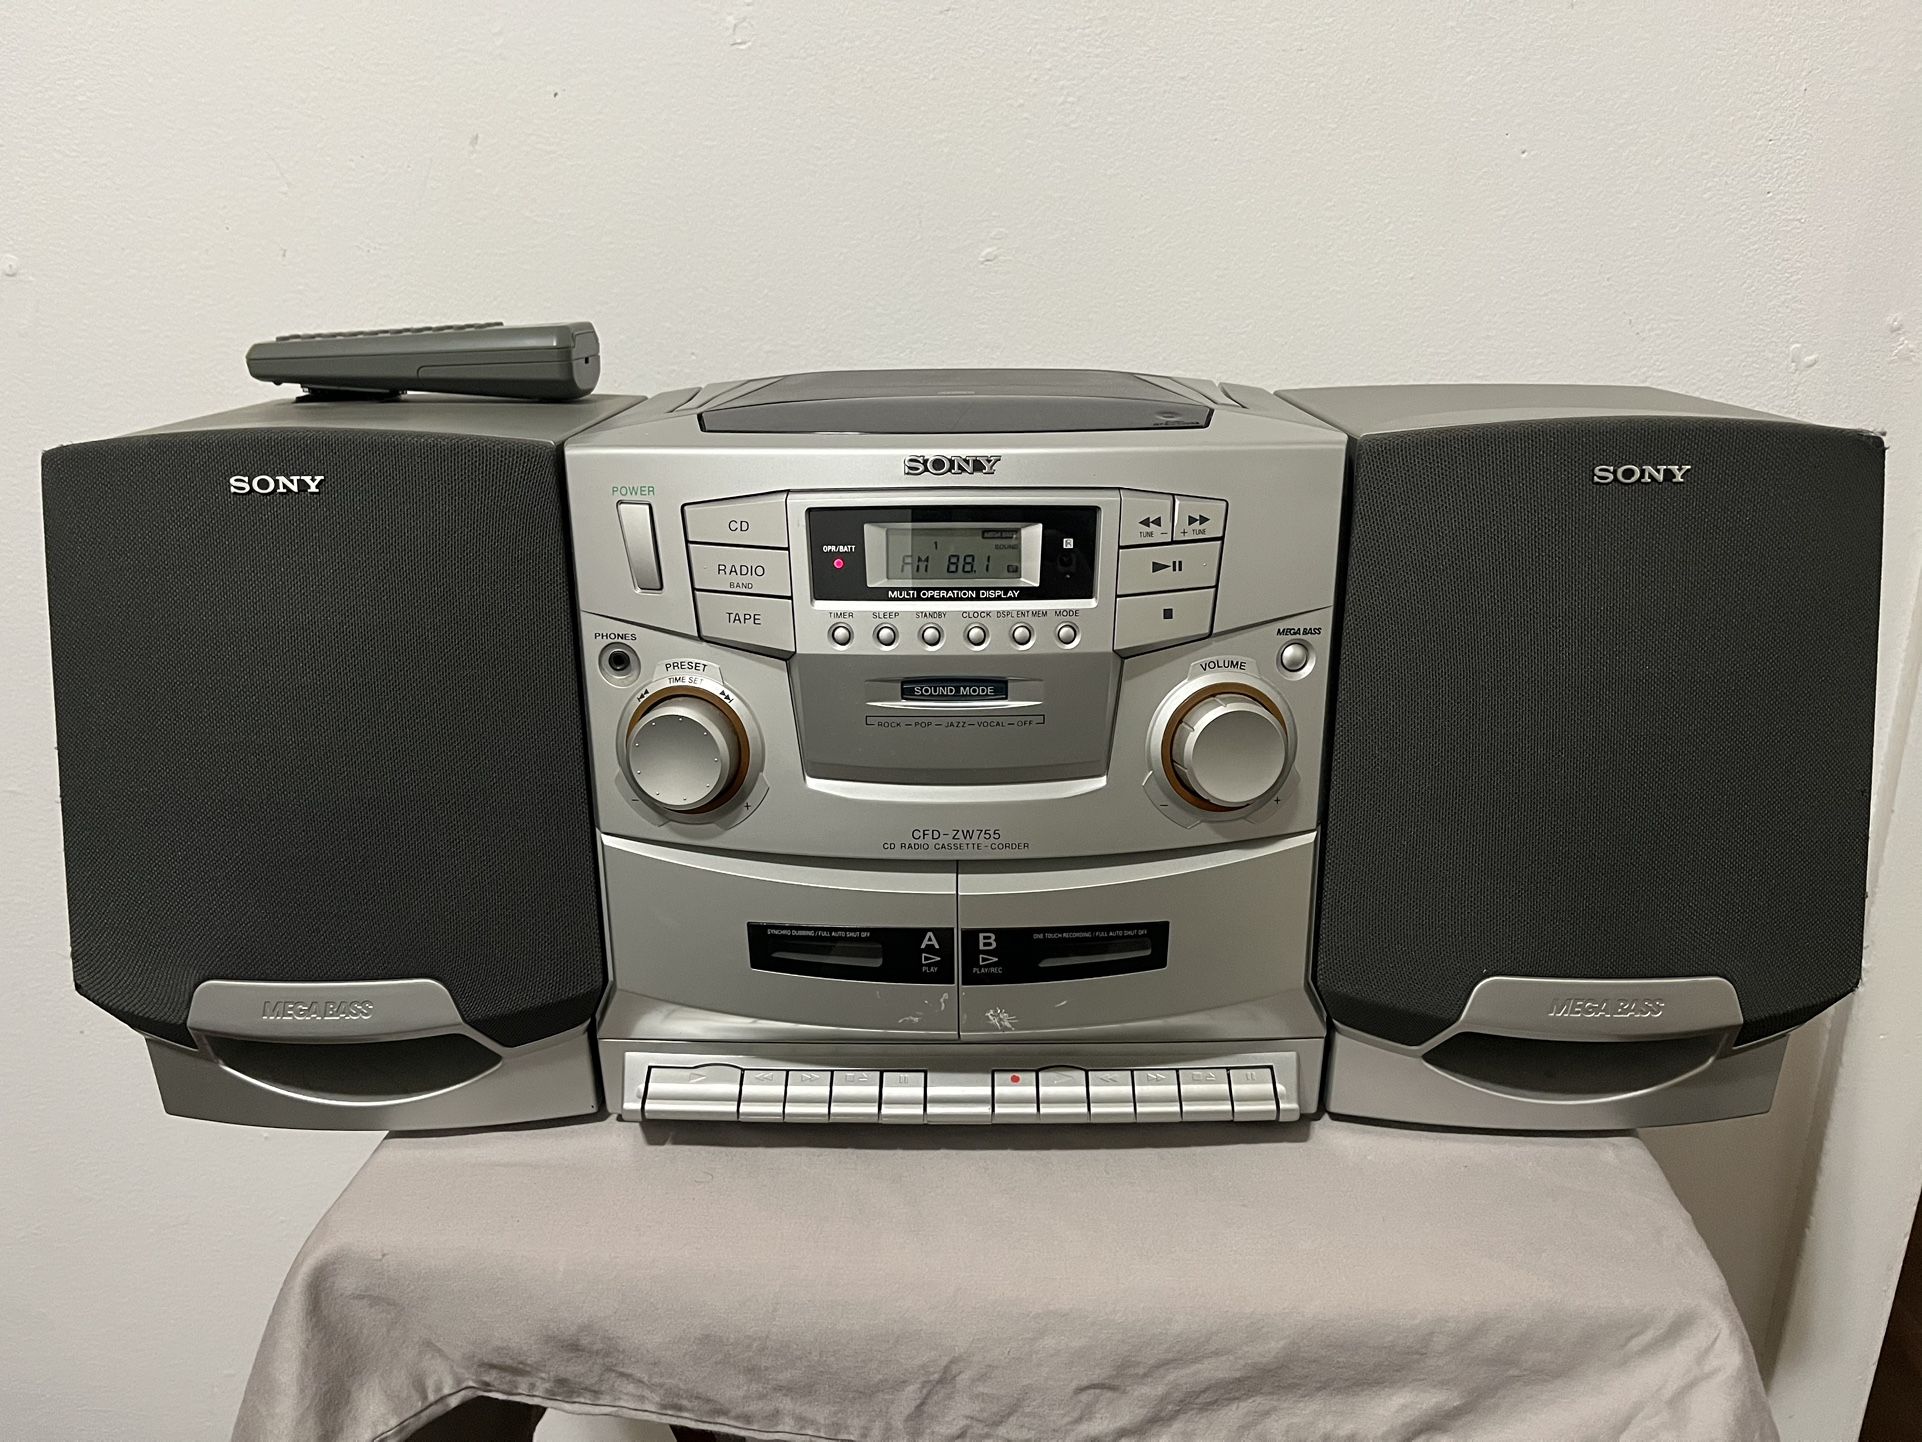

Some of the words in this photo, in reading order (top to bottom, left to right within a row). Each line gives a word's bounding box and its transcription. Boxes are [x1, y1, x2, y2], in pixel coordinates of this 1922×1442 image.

[904, 455, 1001, 476] SONY
[1593, 464, 1692, 483] SONY
[229, 474, 324, 494] SONY
[612, 485, 656, 496] POWER
[728, 520, 750, 532] CD
[822, 545, 856, 553] OPR/BATT
[901, 555, 930, 573] FM
[946, 554, 991, 573] 88.1
[717, 564, 766, 577] RADIO
[729, 582, 753, 590] BAND
[888, 590, 917, 598] MULTI
[920, 590, 976, 598] OPERATION
[980, 590, 1020, 598] DISPLAY
[726, 612, 762, 626] TAPE
[828, 612, 854, 620] TIMER
[962, 611, 992, 619] CLOCK
[1054, 610, 1080, 618] MODE
[594, 632, 638, 641] PHONES
[1276, 627, 1301, 636] MEGA
[1302, 627, 1322, 636] BASS
[664, 661, 708, 673] PRESET
[1200, 660, 1246, 672] VOLUME
[668, 676, 686, 684] TIME
[688, 677, 704, 685] SET
[914, 686, 956, 696] SOUND
[960, 686, 994, 696] MODE
[912, 829, 1001, 840] CFD-ZW755
[882, 842, 896, 850] CD
[900, 842, 930, 850] RADIO
[920, 932, 940, 949] A
[978, 932, 997, 950] B
[262, 1000, 320, 1020] MEGA
[323, 1000, 374, 1020] BASS
[1548, 998, 1610, 1017] MEGA
[1613, 998, 1665, 1018] BASS
